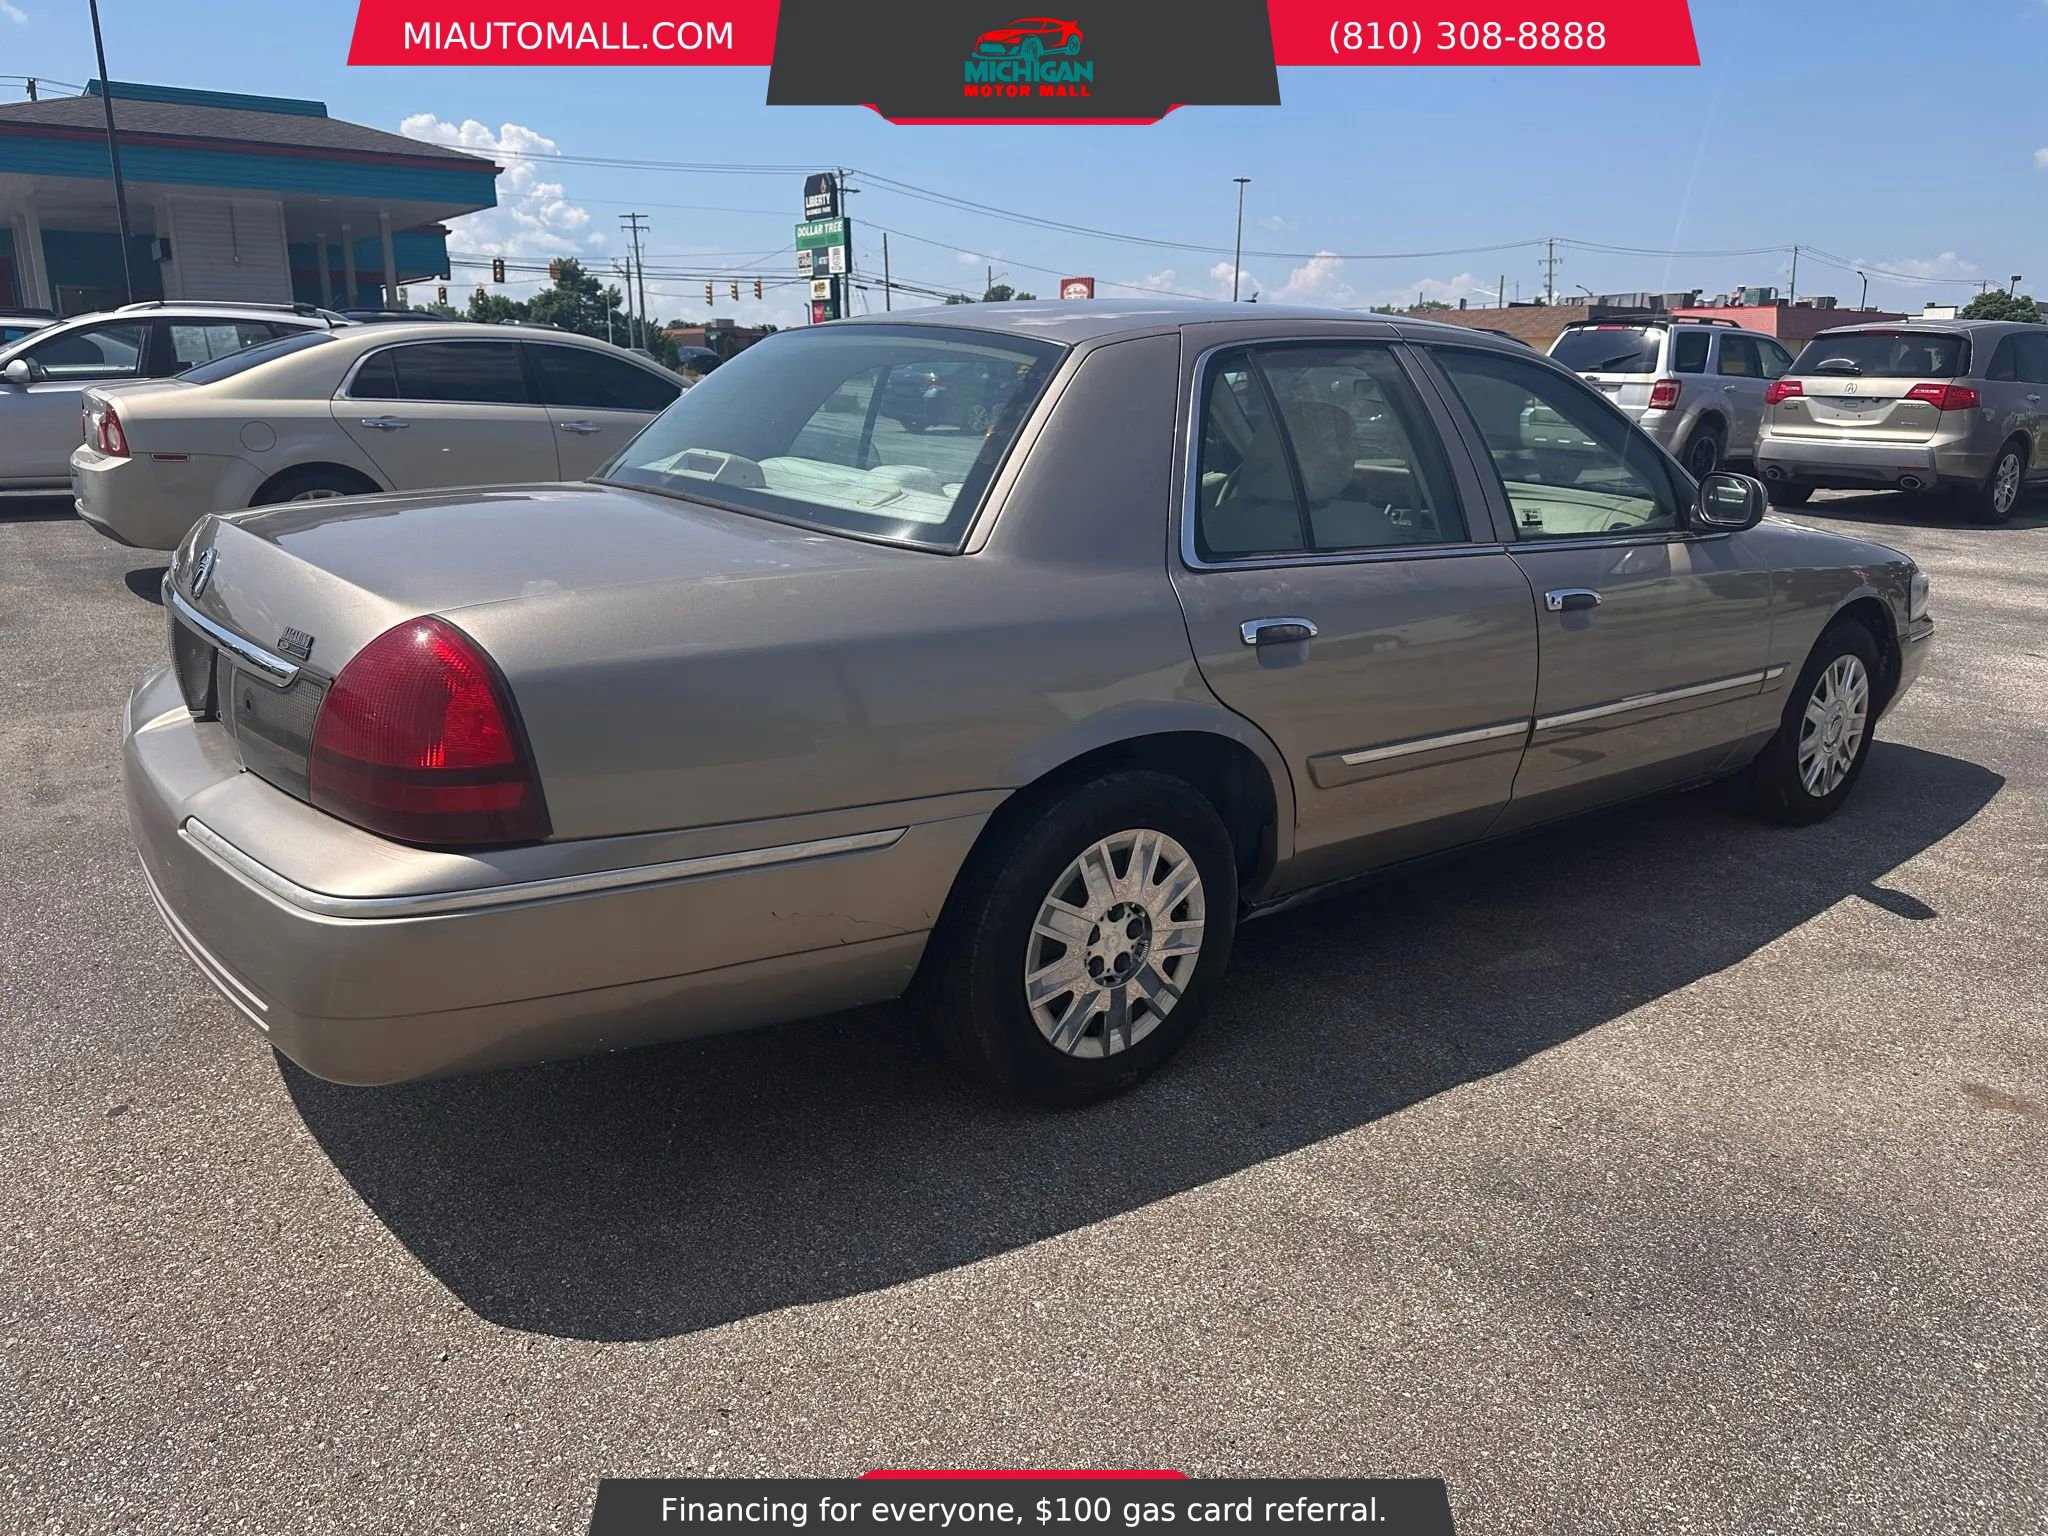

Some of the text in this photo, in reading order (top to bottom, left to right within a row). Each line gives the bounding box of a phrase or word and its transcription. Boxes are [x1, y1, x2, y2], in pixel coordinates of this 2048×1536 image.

[806, 193, 831, 208] LIBERTY
[797, 221, 842, 237] DOLLAR TREE
